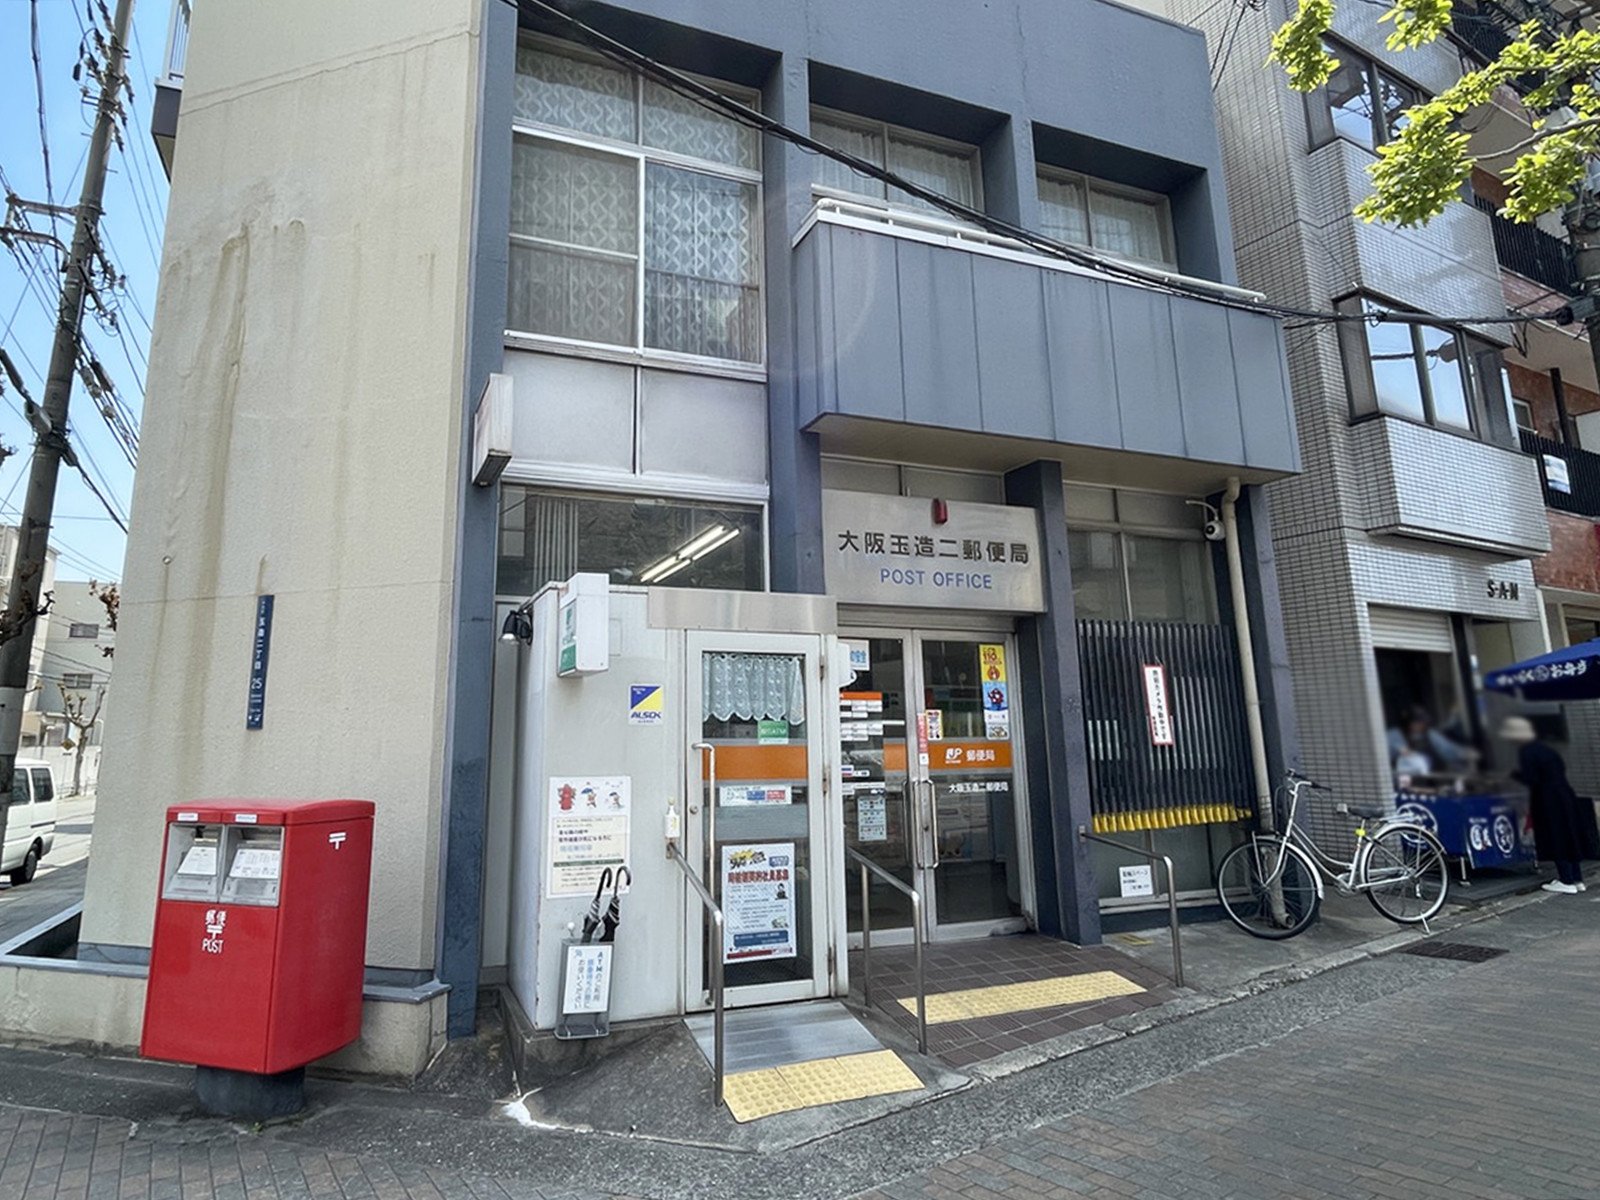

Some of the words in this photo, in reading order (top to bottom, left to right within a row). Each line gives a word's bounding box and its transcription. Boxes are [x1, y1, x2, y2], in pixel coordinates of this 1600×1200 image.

[838, 530, 1029, 564] 大阪玉造二郵便局
[881, 568, 925, 585] POST
[932, 571, 992, 590] OFFICE
[966, 748, 995, 762] 郵便局
[948, 781, 1009, 793] 大阪玉造二郵便局
[205, 909, 227, 926] 郵便
[202, 938, 223, 953] POST
